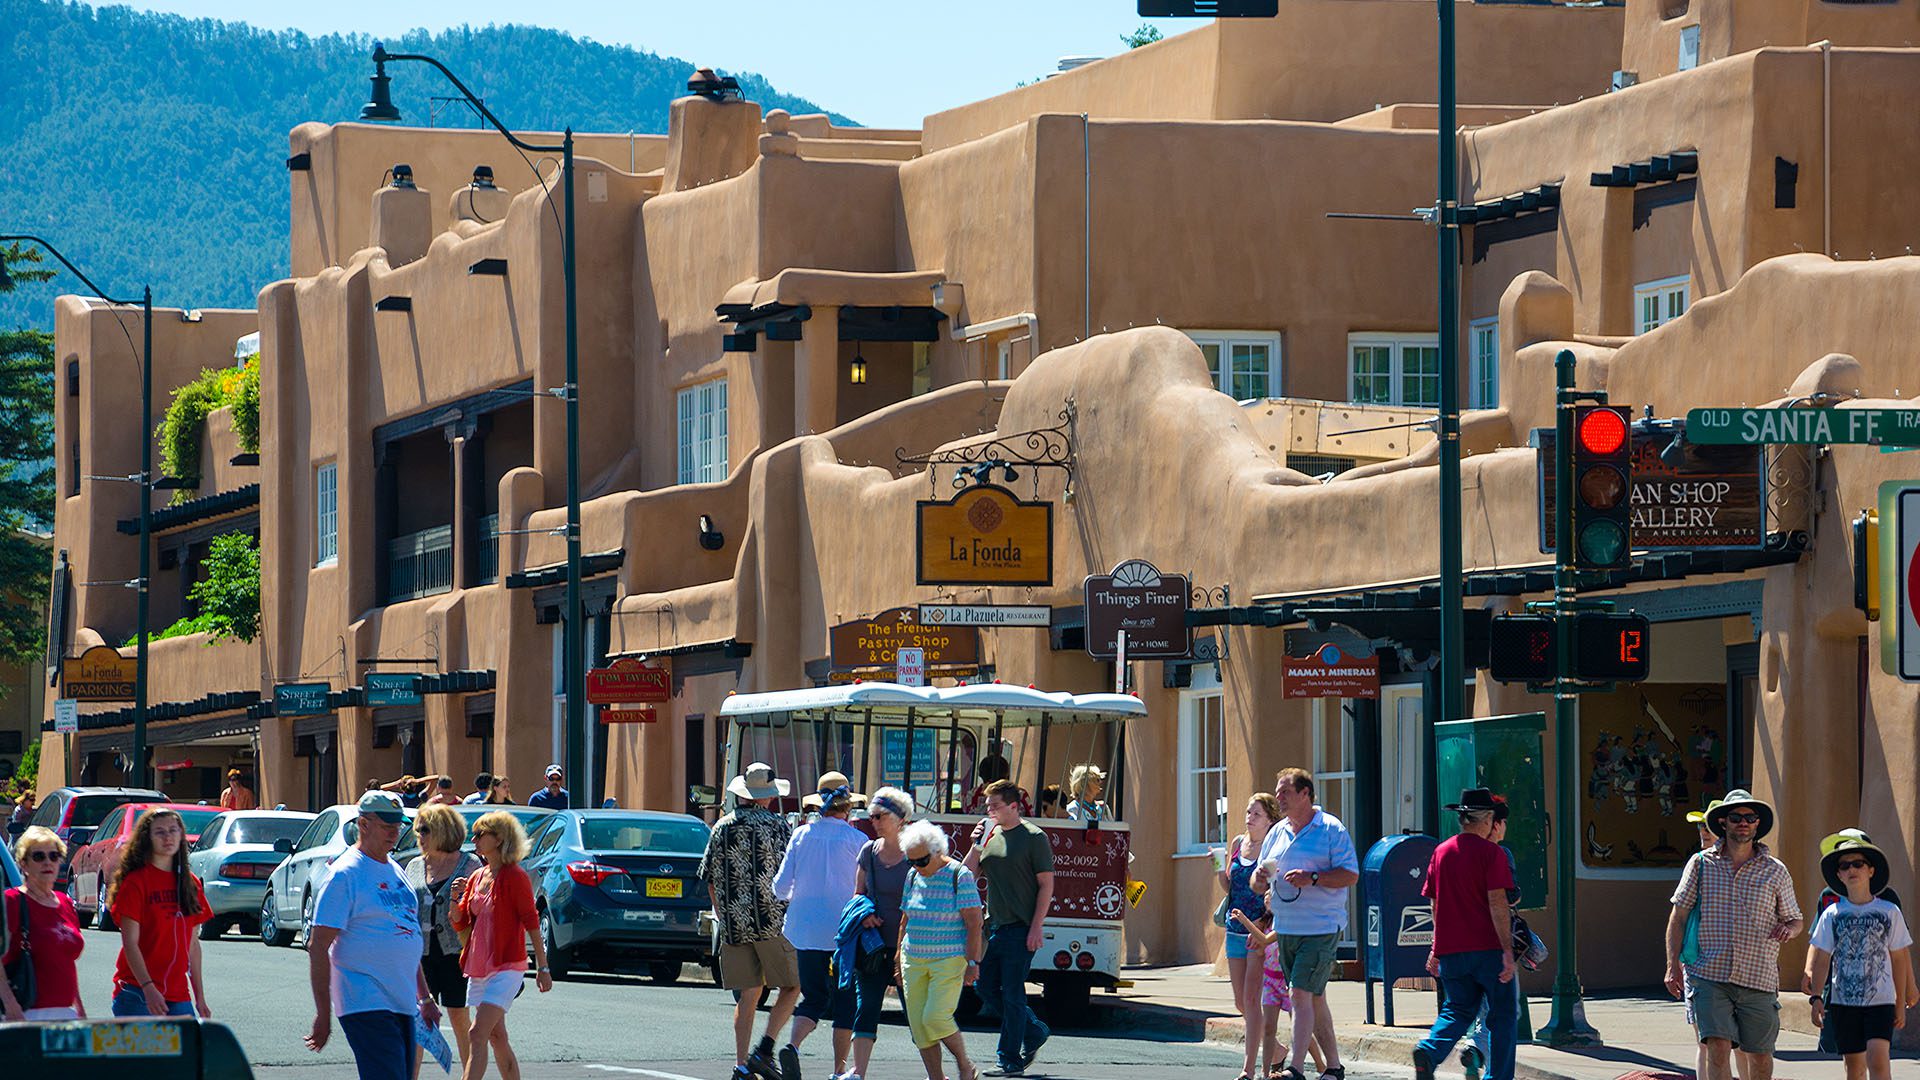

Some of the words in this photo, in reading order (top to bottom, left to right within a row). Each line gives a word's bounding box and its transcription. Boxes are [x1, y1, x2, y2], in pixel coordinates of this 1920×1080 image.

[1701, 410, 1730, 427] OLD
[1741, 411, 1832, 442] SANTA
[1849, 411, 1883, 442] FE
[1670, 482, 1730, 504] SHOP
[1631, 507, 1719, 528] ALLERY
[1653, 529, 1719, 537] AMERICAN
[1724, 528, 1755, 536] RTS
[949, 536, 967, 561] La
[973, 537, 1021, 566] Fonda
[1096, 592, 1140, 608] Things
[1145, 592, 1179, 604] Finer
[951, 609, 961, 622] La
[965, 609, 1005, 622] Plazuela
[867, 624, 891, 635] The
[896, 622, 941, 635] French
[858, 636, 904, 648] Pastry
[913, 635, 949, 648] Shop
[1620, 630, 1641, 663] 12
[869, 651, 877, 662] &
[881, 650, 940, 662] Crrie
[905, 654, 916, 664] NO
[81, 664, 92, 678] La
[94, 664, 122, 680] Fonda
[899, 665, 922, 676] PARKING
[1288, 669, 1325, 677] MAMA'S
[1328, 668, 1376, 676] MINERALS
[596, 673, 621, 686] TOM
[624, 673, 665, 688] TAYLOR
[70, 684, 131, 695] PARKING
[612, 712, 647, 720] OPEN
[1052, 854, 1099, 866] 982-0092
[1053, 868, 1097, 878] antafe.com
